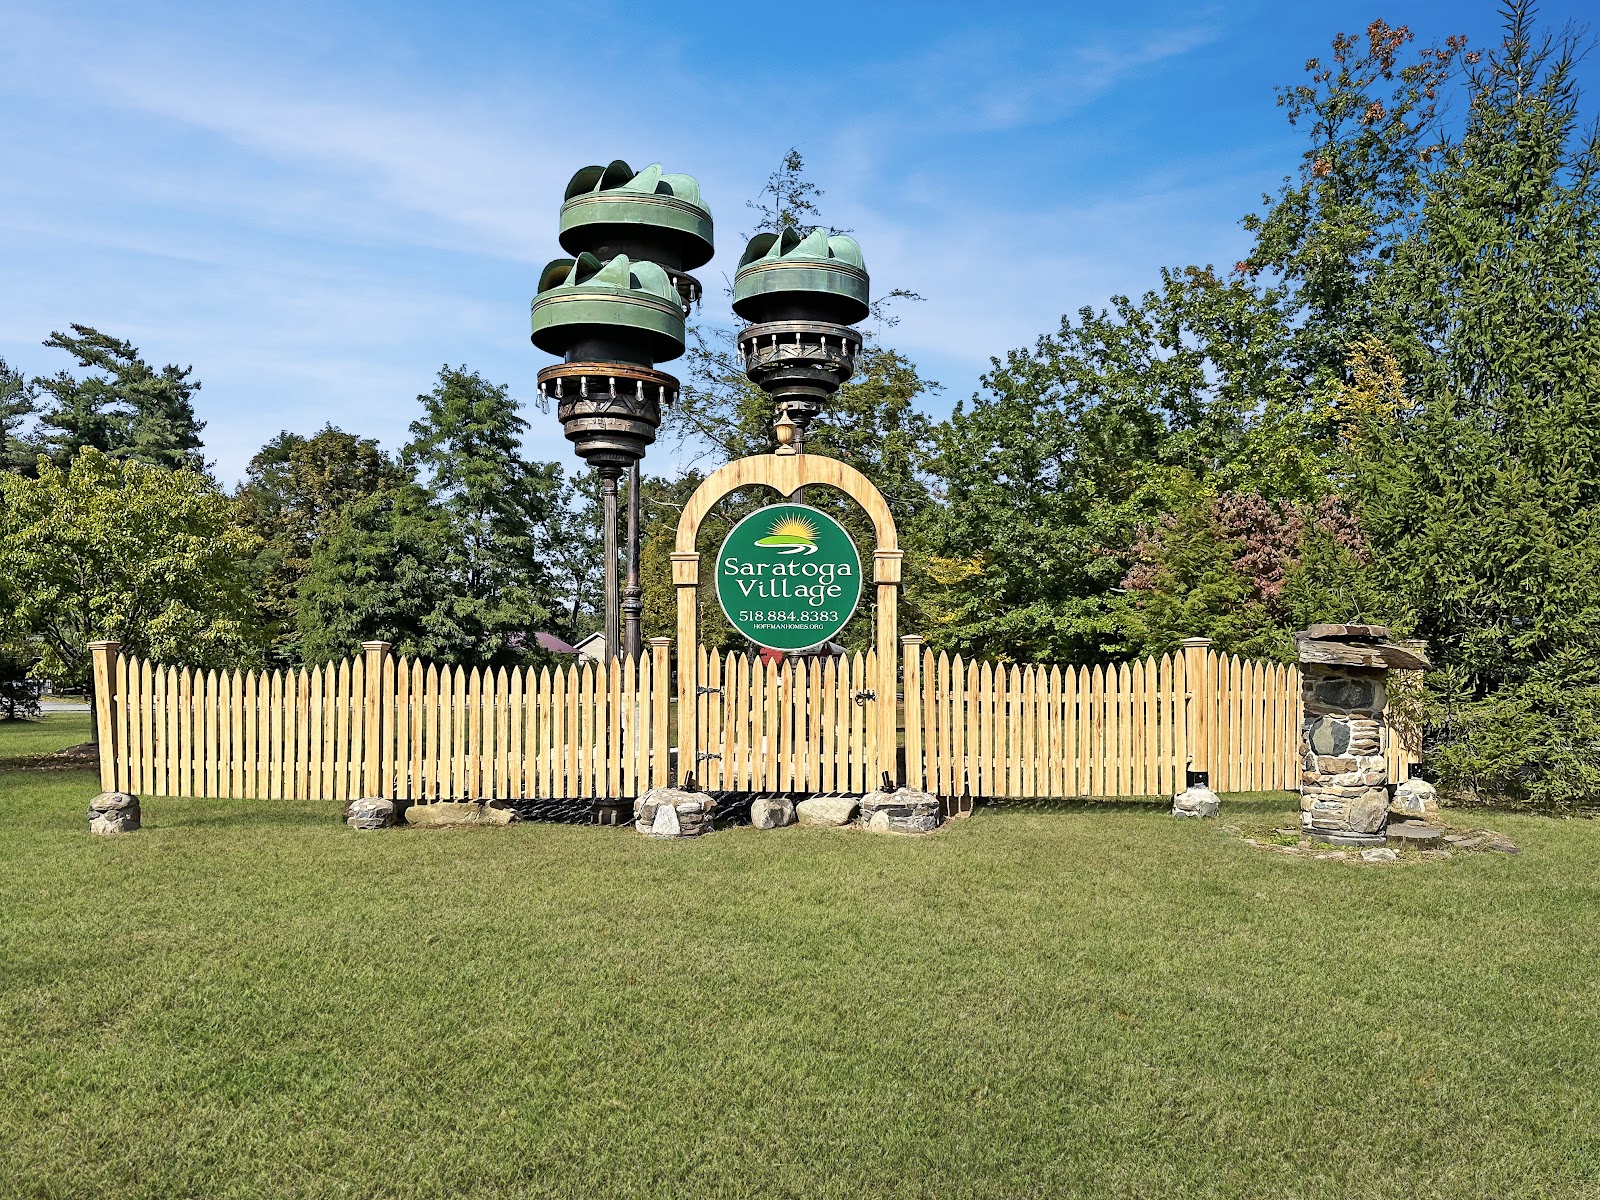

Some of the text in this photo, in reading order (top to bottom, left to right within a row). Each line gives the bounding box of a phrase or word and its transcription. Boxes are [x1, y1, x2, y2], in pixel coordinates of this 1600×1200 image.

[724, 557, 853, 585] Saratoga
[735, 578, 842, 607] Village
[739, 610, 839, 622] 518.884.8383
